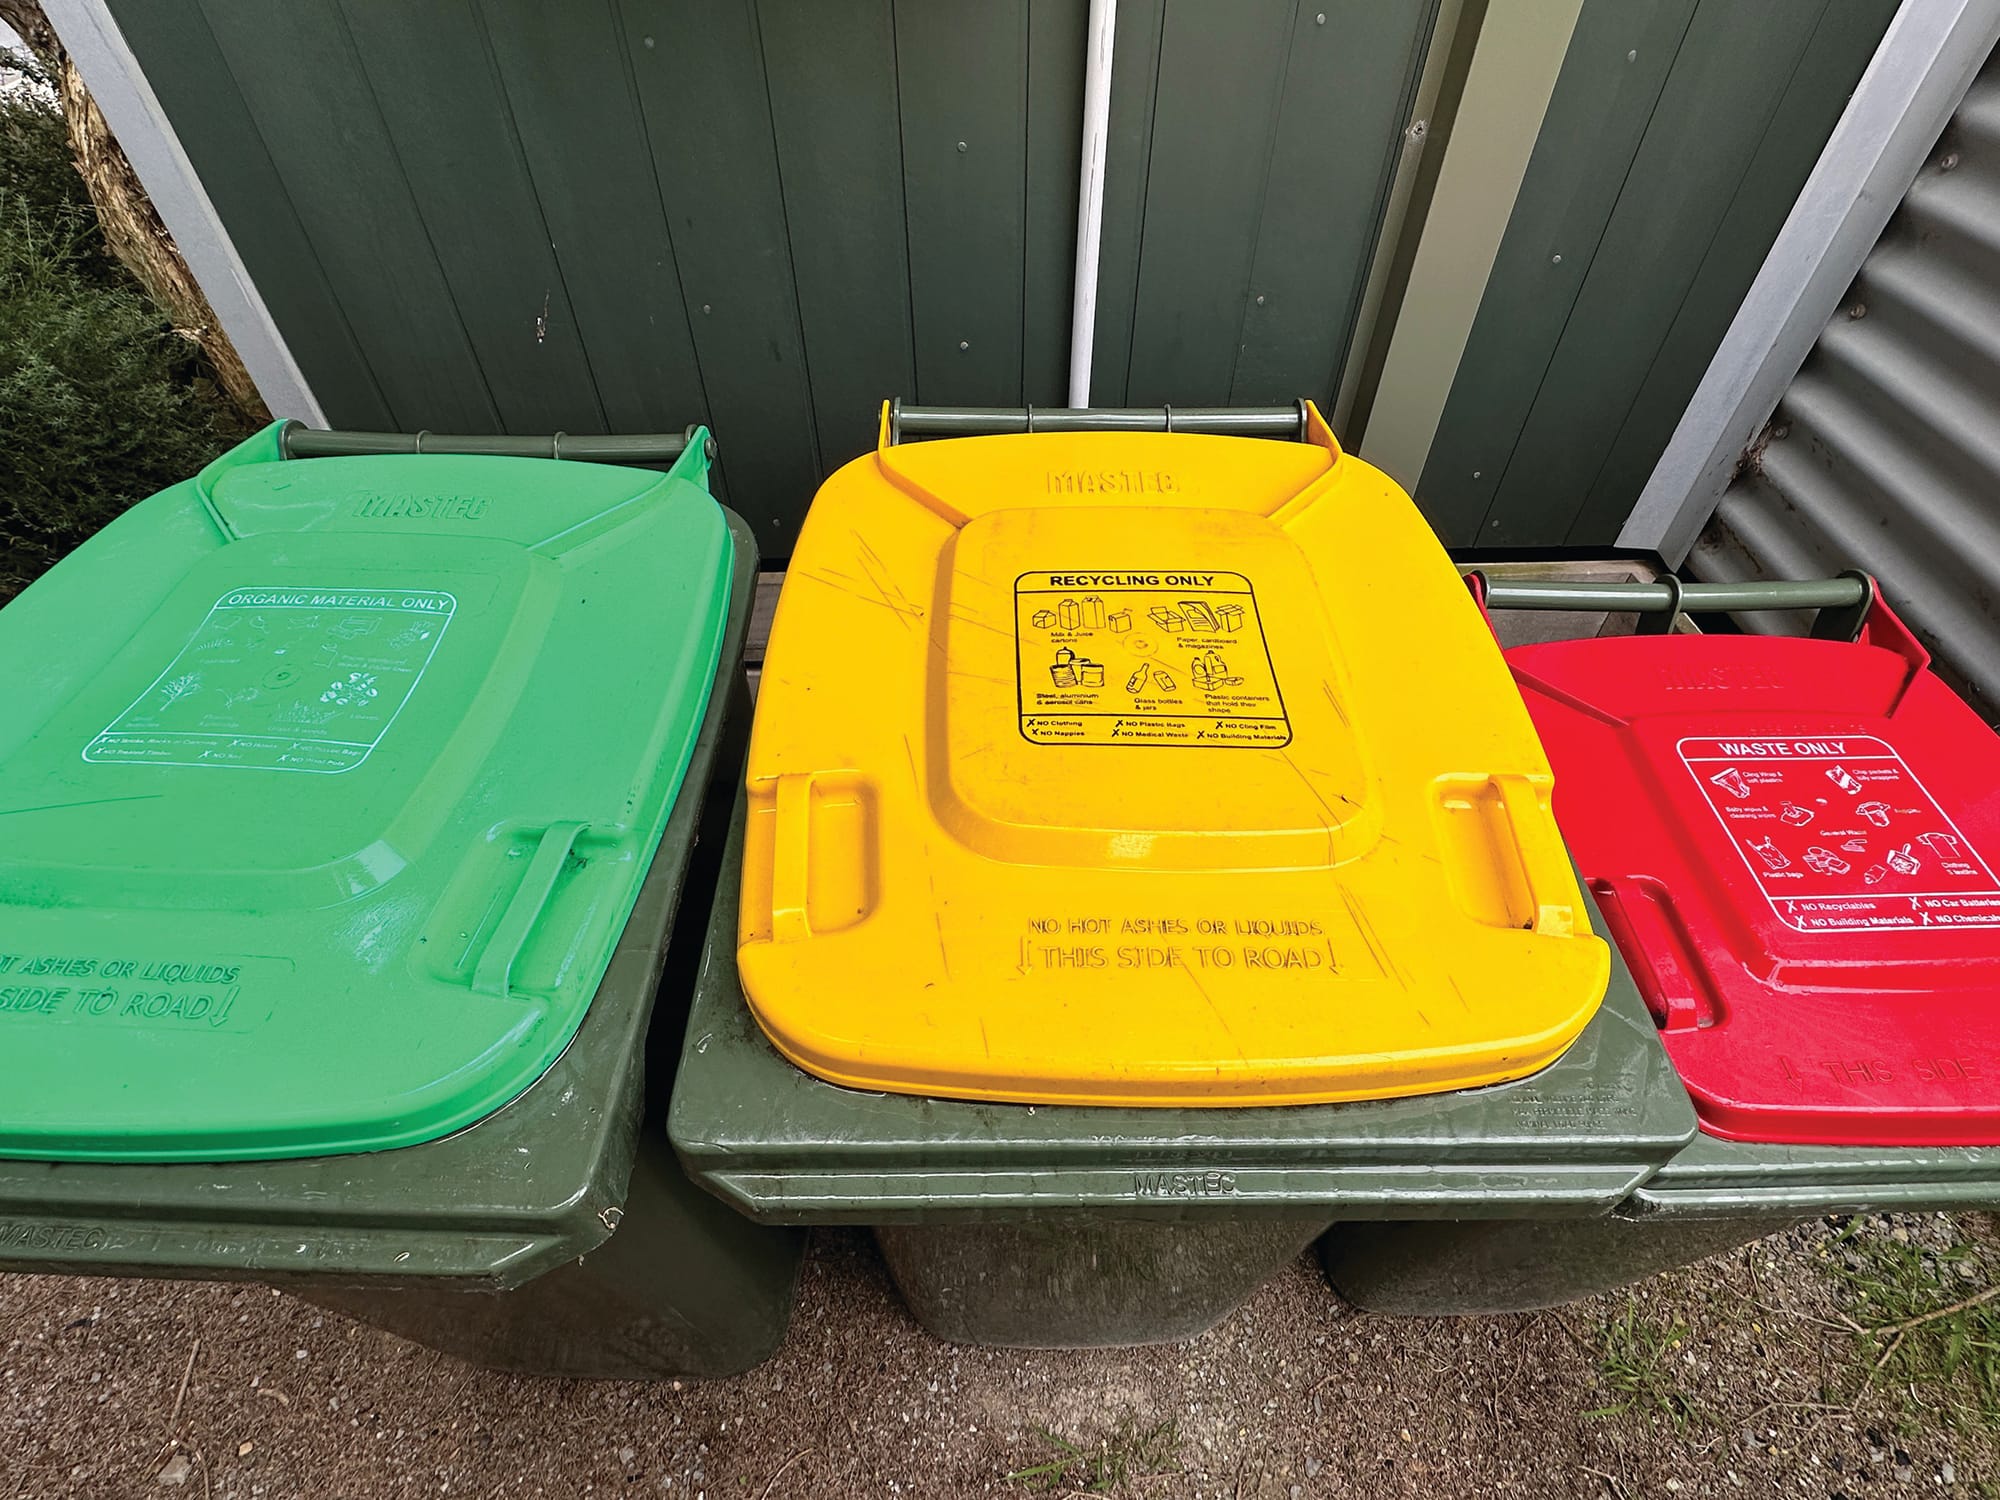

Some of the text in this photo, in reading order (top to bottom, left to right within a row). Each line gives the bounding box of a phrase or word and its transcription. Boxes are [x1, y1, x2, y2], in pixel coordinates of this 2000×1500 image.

[352, 495, 493, 519] MASTEC
[1050, 575, 1215, 587] RECYCLING ONLY
[228, 593, 450, 611] ORGANIC MATERIAL ONLY
[1718, 741, 1847, 756] WASTE ONLY
[1801, 901, 1877, 912] NO Recyclables
[1924, 899, 1941, 908] NO
[1941, 899, 1960, 907] Car
[1027, 917, 1325, 940] NO HOT ASHES OR LIQUIDS
[1810, 915, 1915, 928] NO Building Materials
[1935, 914, 1953, 923] NO
[1038, 945, 1323, 970] THIS SIDE TO ROAD
[17, 954, 99, 978] ASHES
[99, 958, 138, 980] OR
[138, 960, 243, 986] LIQUIDS
[0, 984, 215, 1021] SIDE TO ROAD
[1821, 1056, 1985, 1085] THIS SIDE
[1133, 1170, 1238, 1197] MASTEC
[0, 1223, 106, 1249] MASTEC
